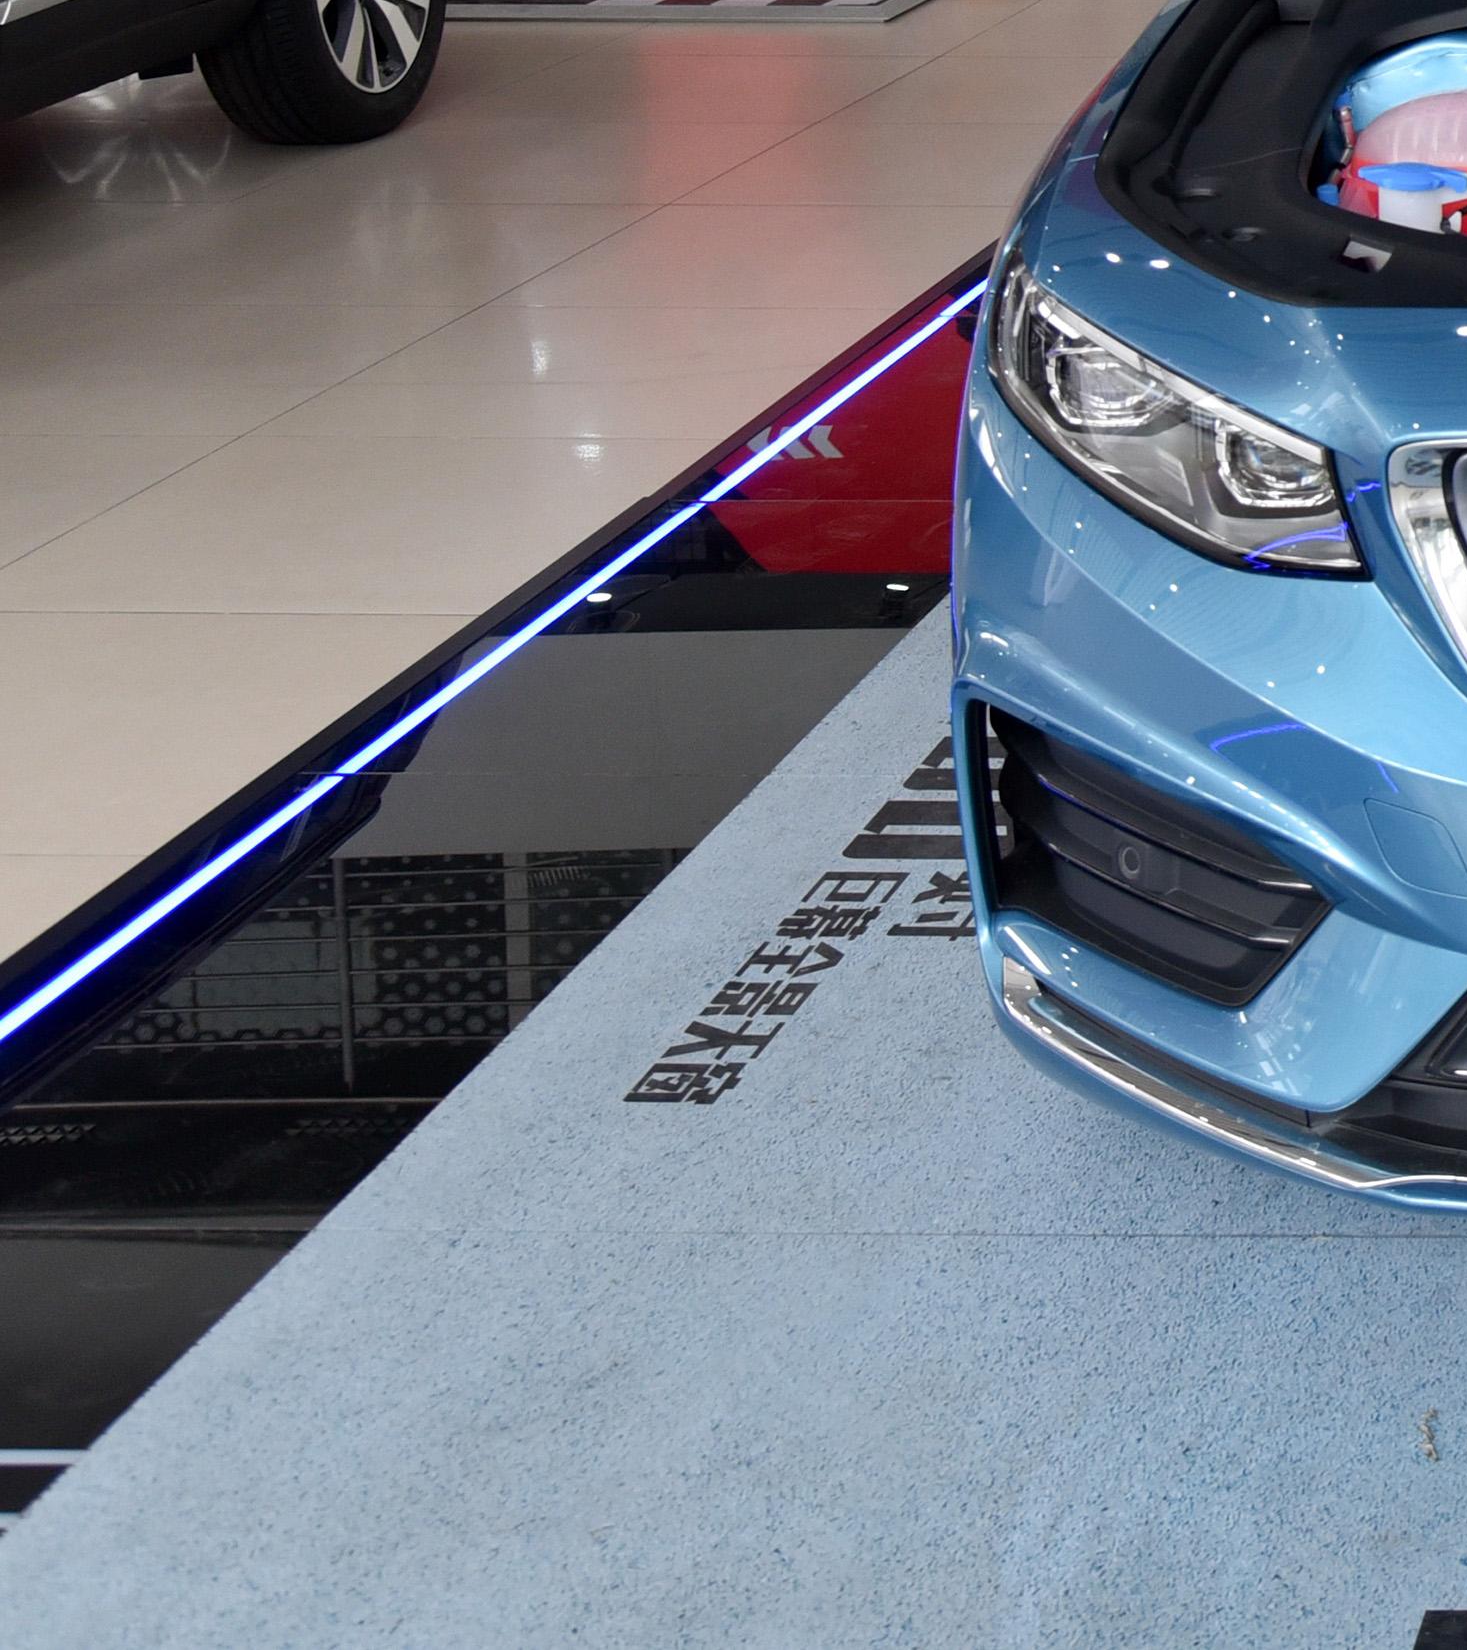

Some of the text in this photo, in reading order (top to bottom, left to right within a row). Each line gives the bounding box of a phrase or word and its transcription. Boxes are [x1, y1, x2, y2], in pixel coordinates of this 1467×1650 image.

[622, 870, 911, 1105] 巨幕全景天窗
